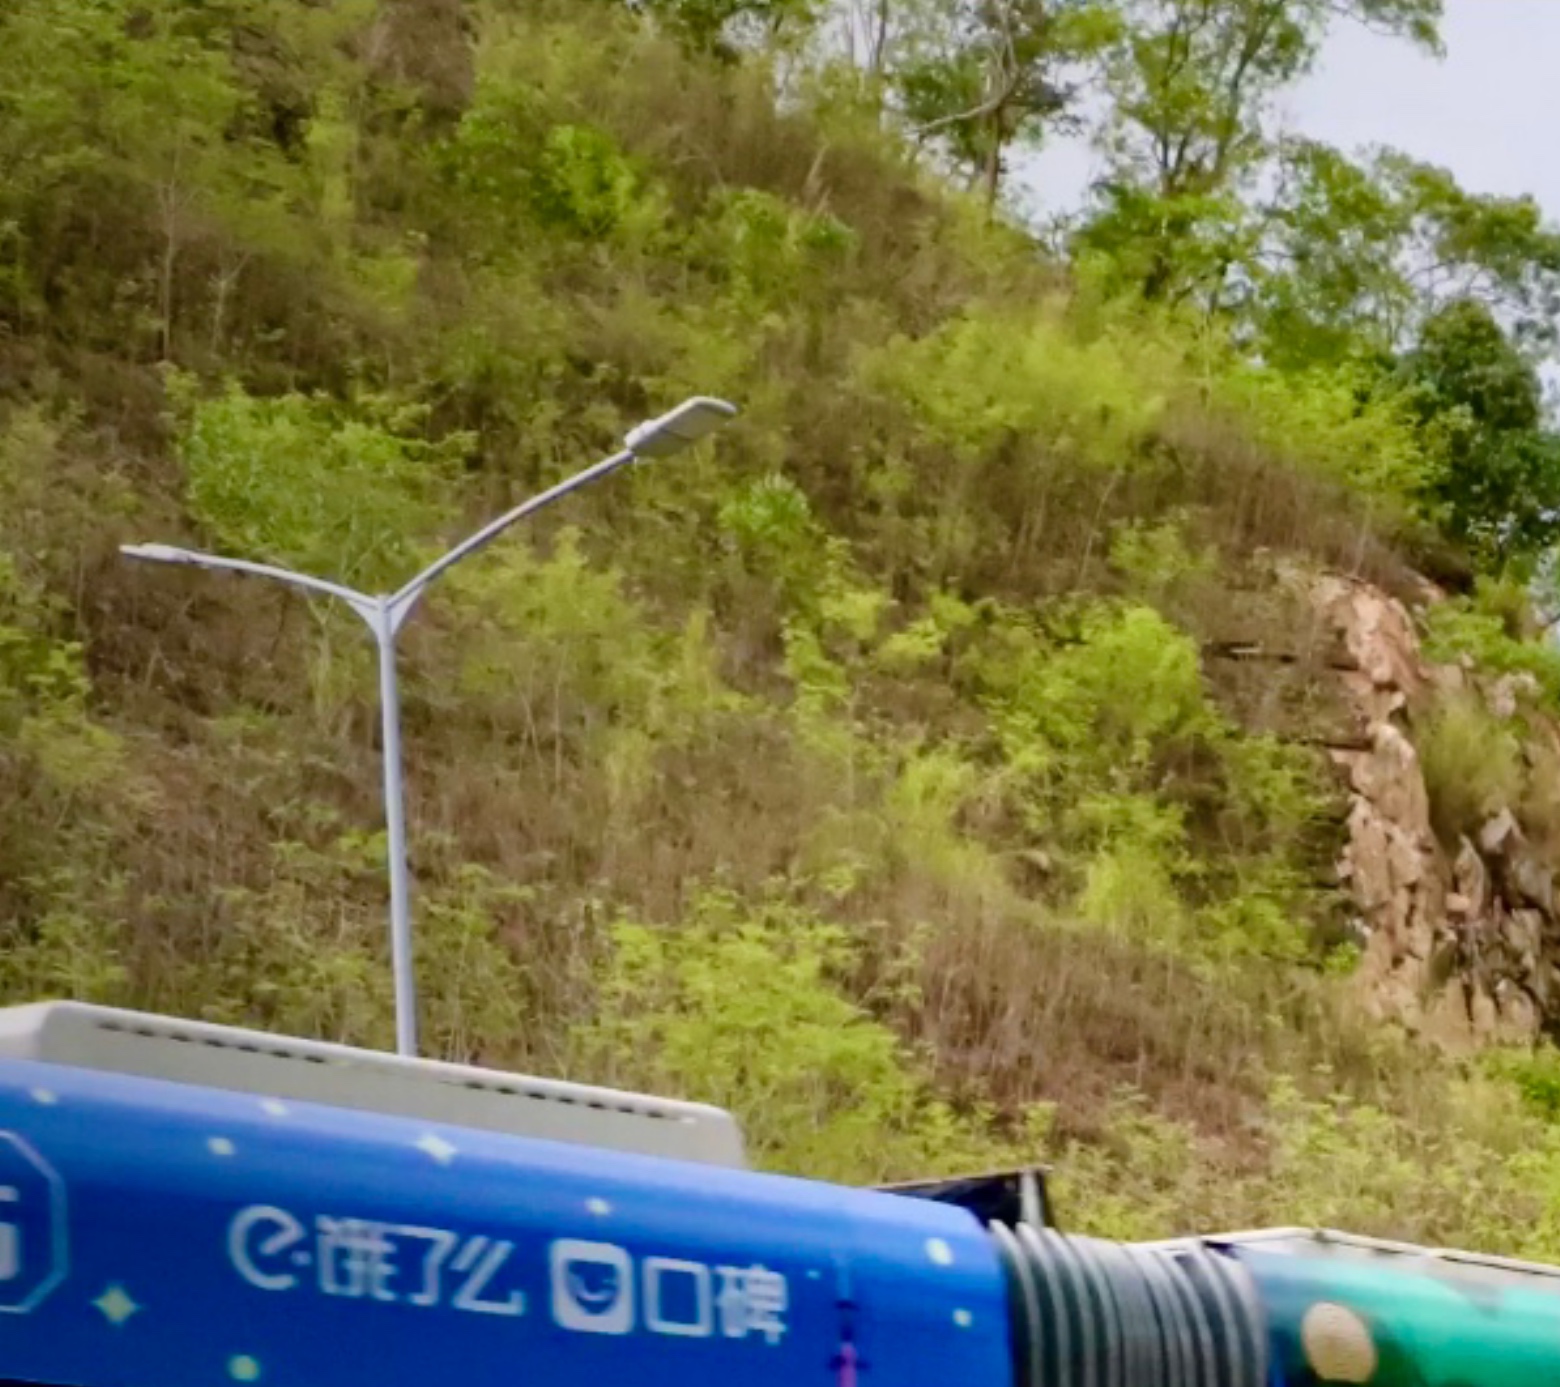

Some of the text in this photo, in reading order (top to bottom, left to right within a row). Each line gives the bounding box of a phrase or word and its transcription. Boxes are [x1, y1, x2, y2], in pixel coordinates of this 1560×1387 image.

[316, 1214, 526, 1318] 饿了么
[644, 1254, 790, 1346] 口碑
